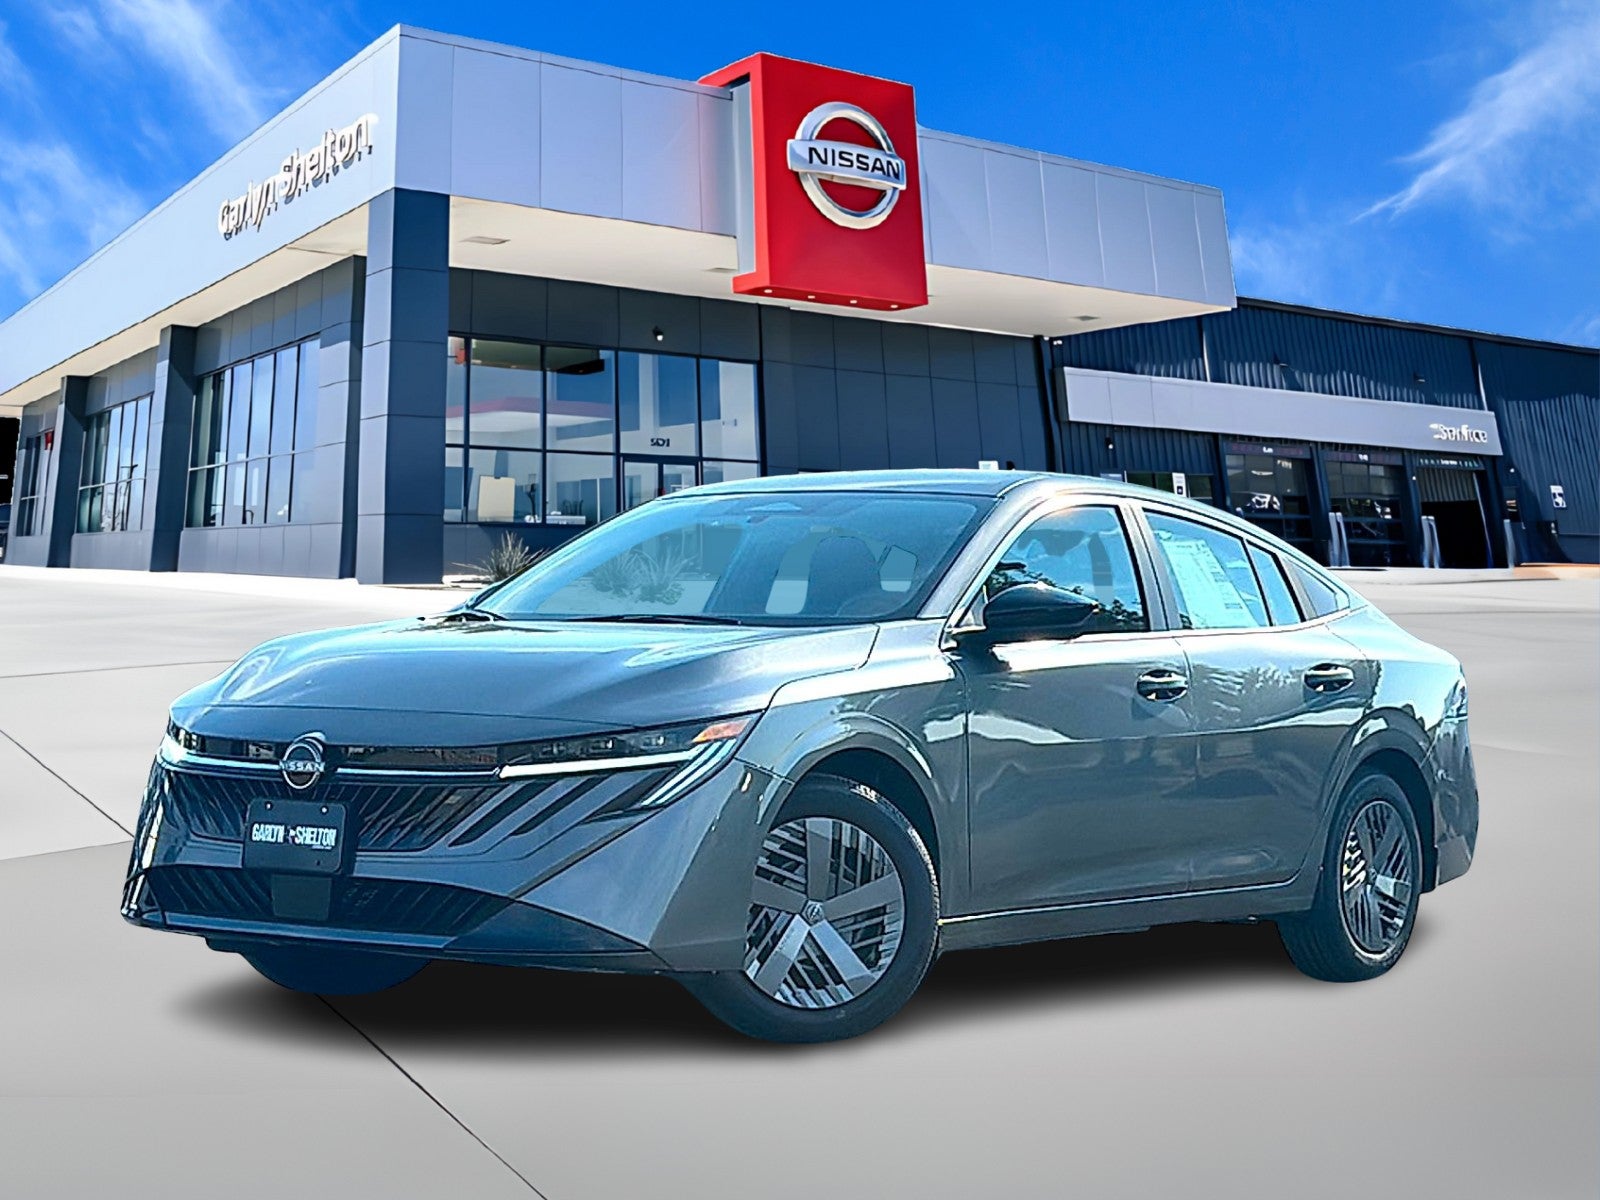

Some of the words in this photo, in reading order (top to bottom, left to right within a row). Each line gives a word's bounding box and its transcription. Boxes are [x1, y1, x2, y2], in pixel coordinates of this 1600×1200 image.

[278, 116, 376, 198] Shelton
[808, 146, 900, 180] NISSAN
[280, 760, 325, 773] NISSAN
[294, 826, 337, 846] SHELTON
